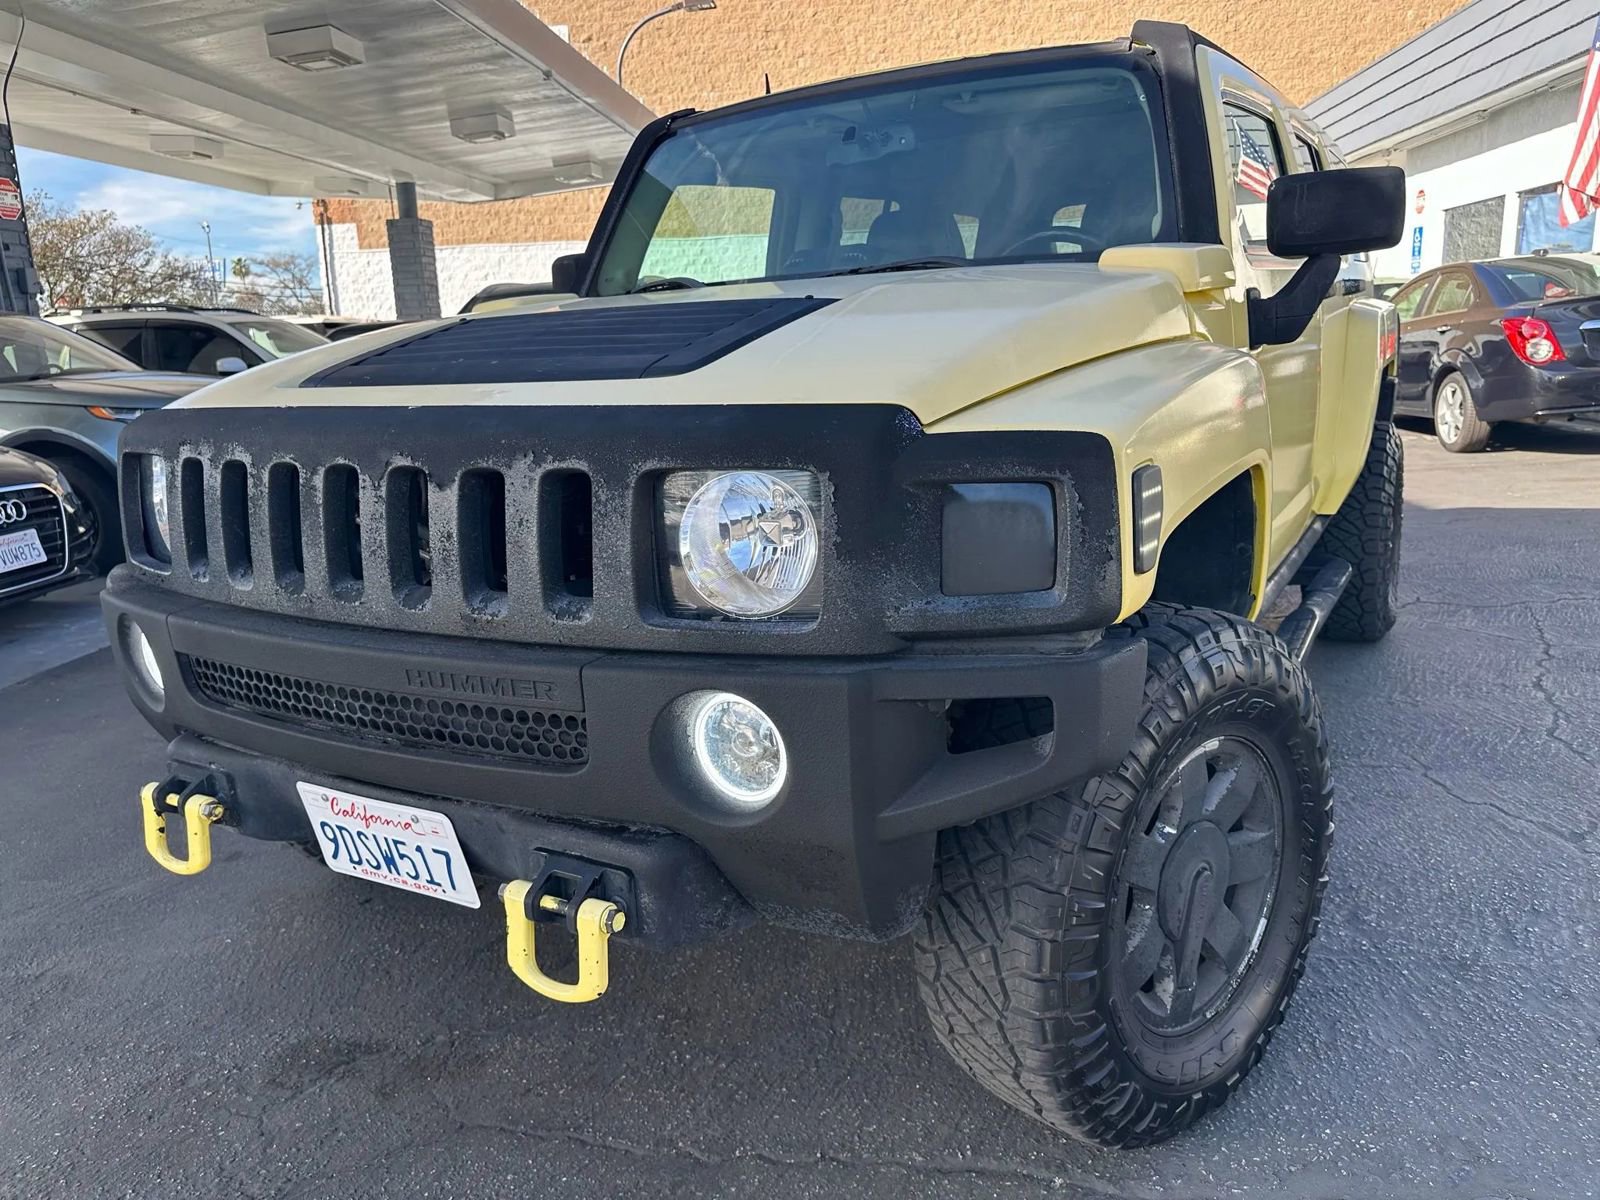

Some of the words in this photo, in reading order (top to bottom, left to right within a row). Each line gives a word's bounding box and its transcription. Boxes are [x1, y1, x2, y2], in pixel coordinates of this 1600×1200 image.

[0, 542, 41, 566] VUW875
[405, 669, 557, 701] HUMMER
[330, 796, 426, 836] California
[320, 821, 457, 891] 9DSW517
[361, 868, 438, 893] dmv.ca.gov
